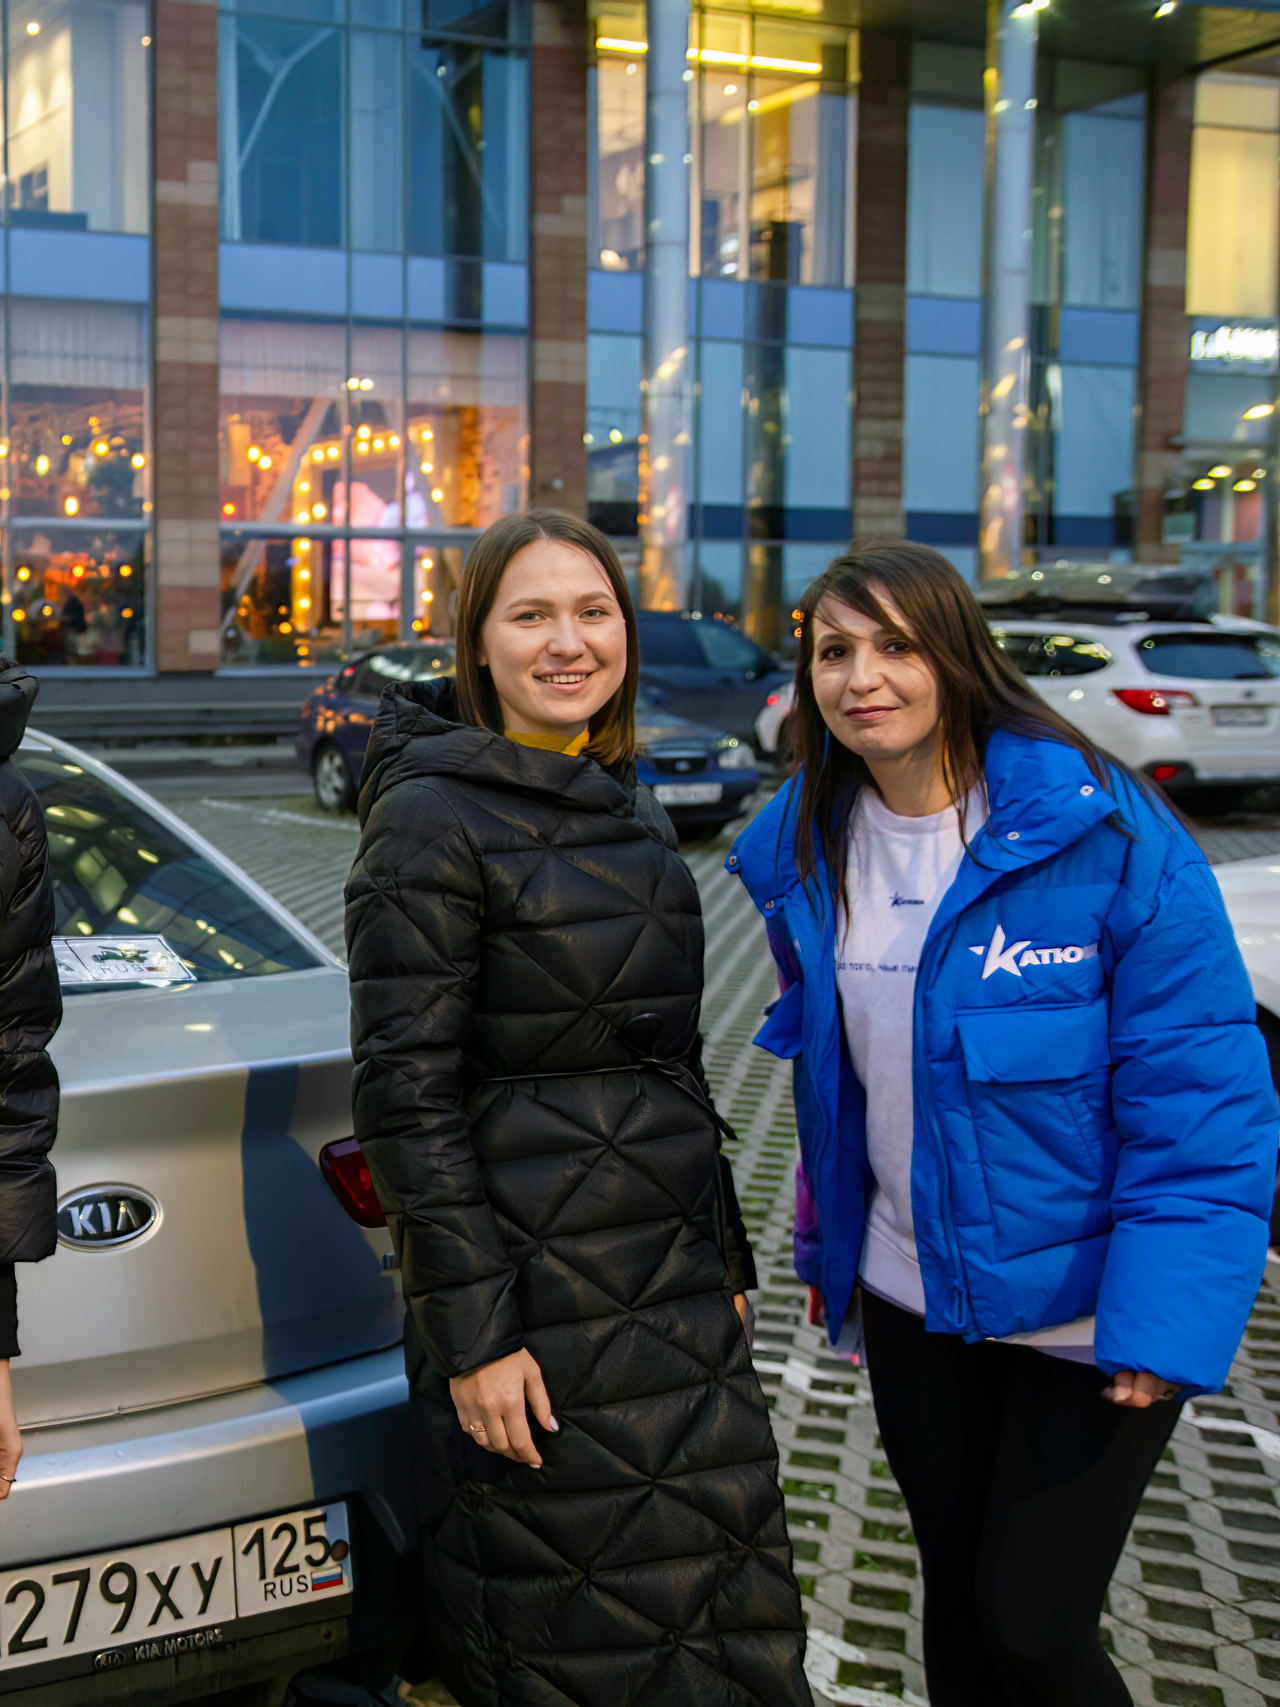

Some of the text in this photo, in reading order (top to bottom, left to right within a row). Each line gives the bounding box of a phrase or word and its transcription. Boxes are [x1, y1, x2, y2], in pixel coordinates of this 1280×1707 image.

[969, 923, 1098, 980] КАТЮ
[67, 1200, 141, 1236] KIA
[241, 1513, 332, 1580] 125
[264, 1575, 309, 1600] RUS
[135, 1643, 160, 1660] KIA
[165, 1628, 223, 1654] MOTORS
